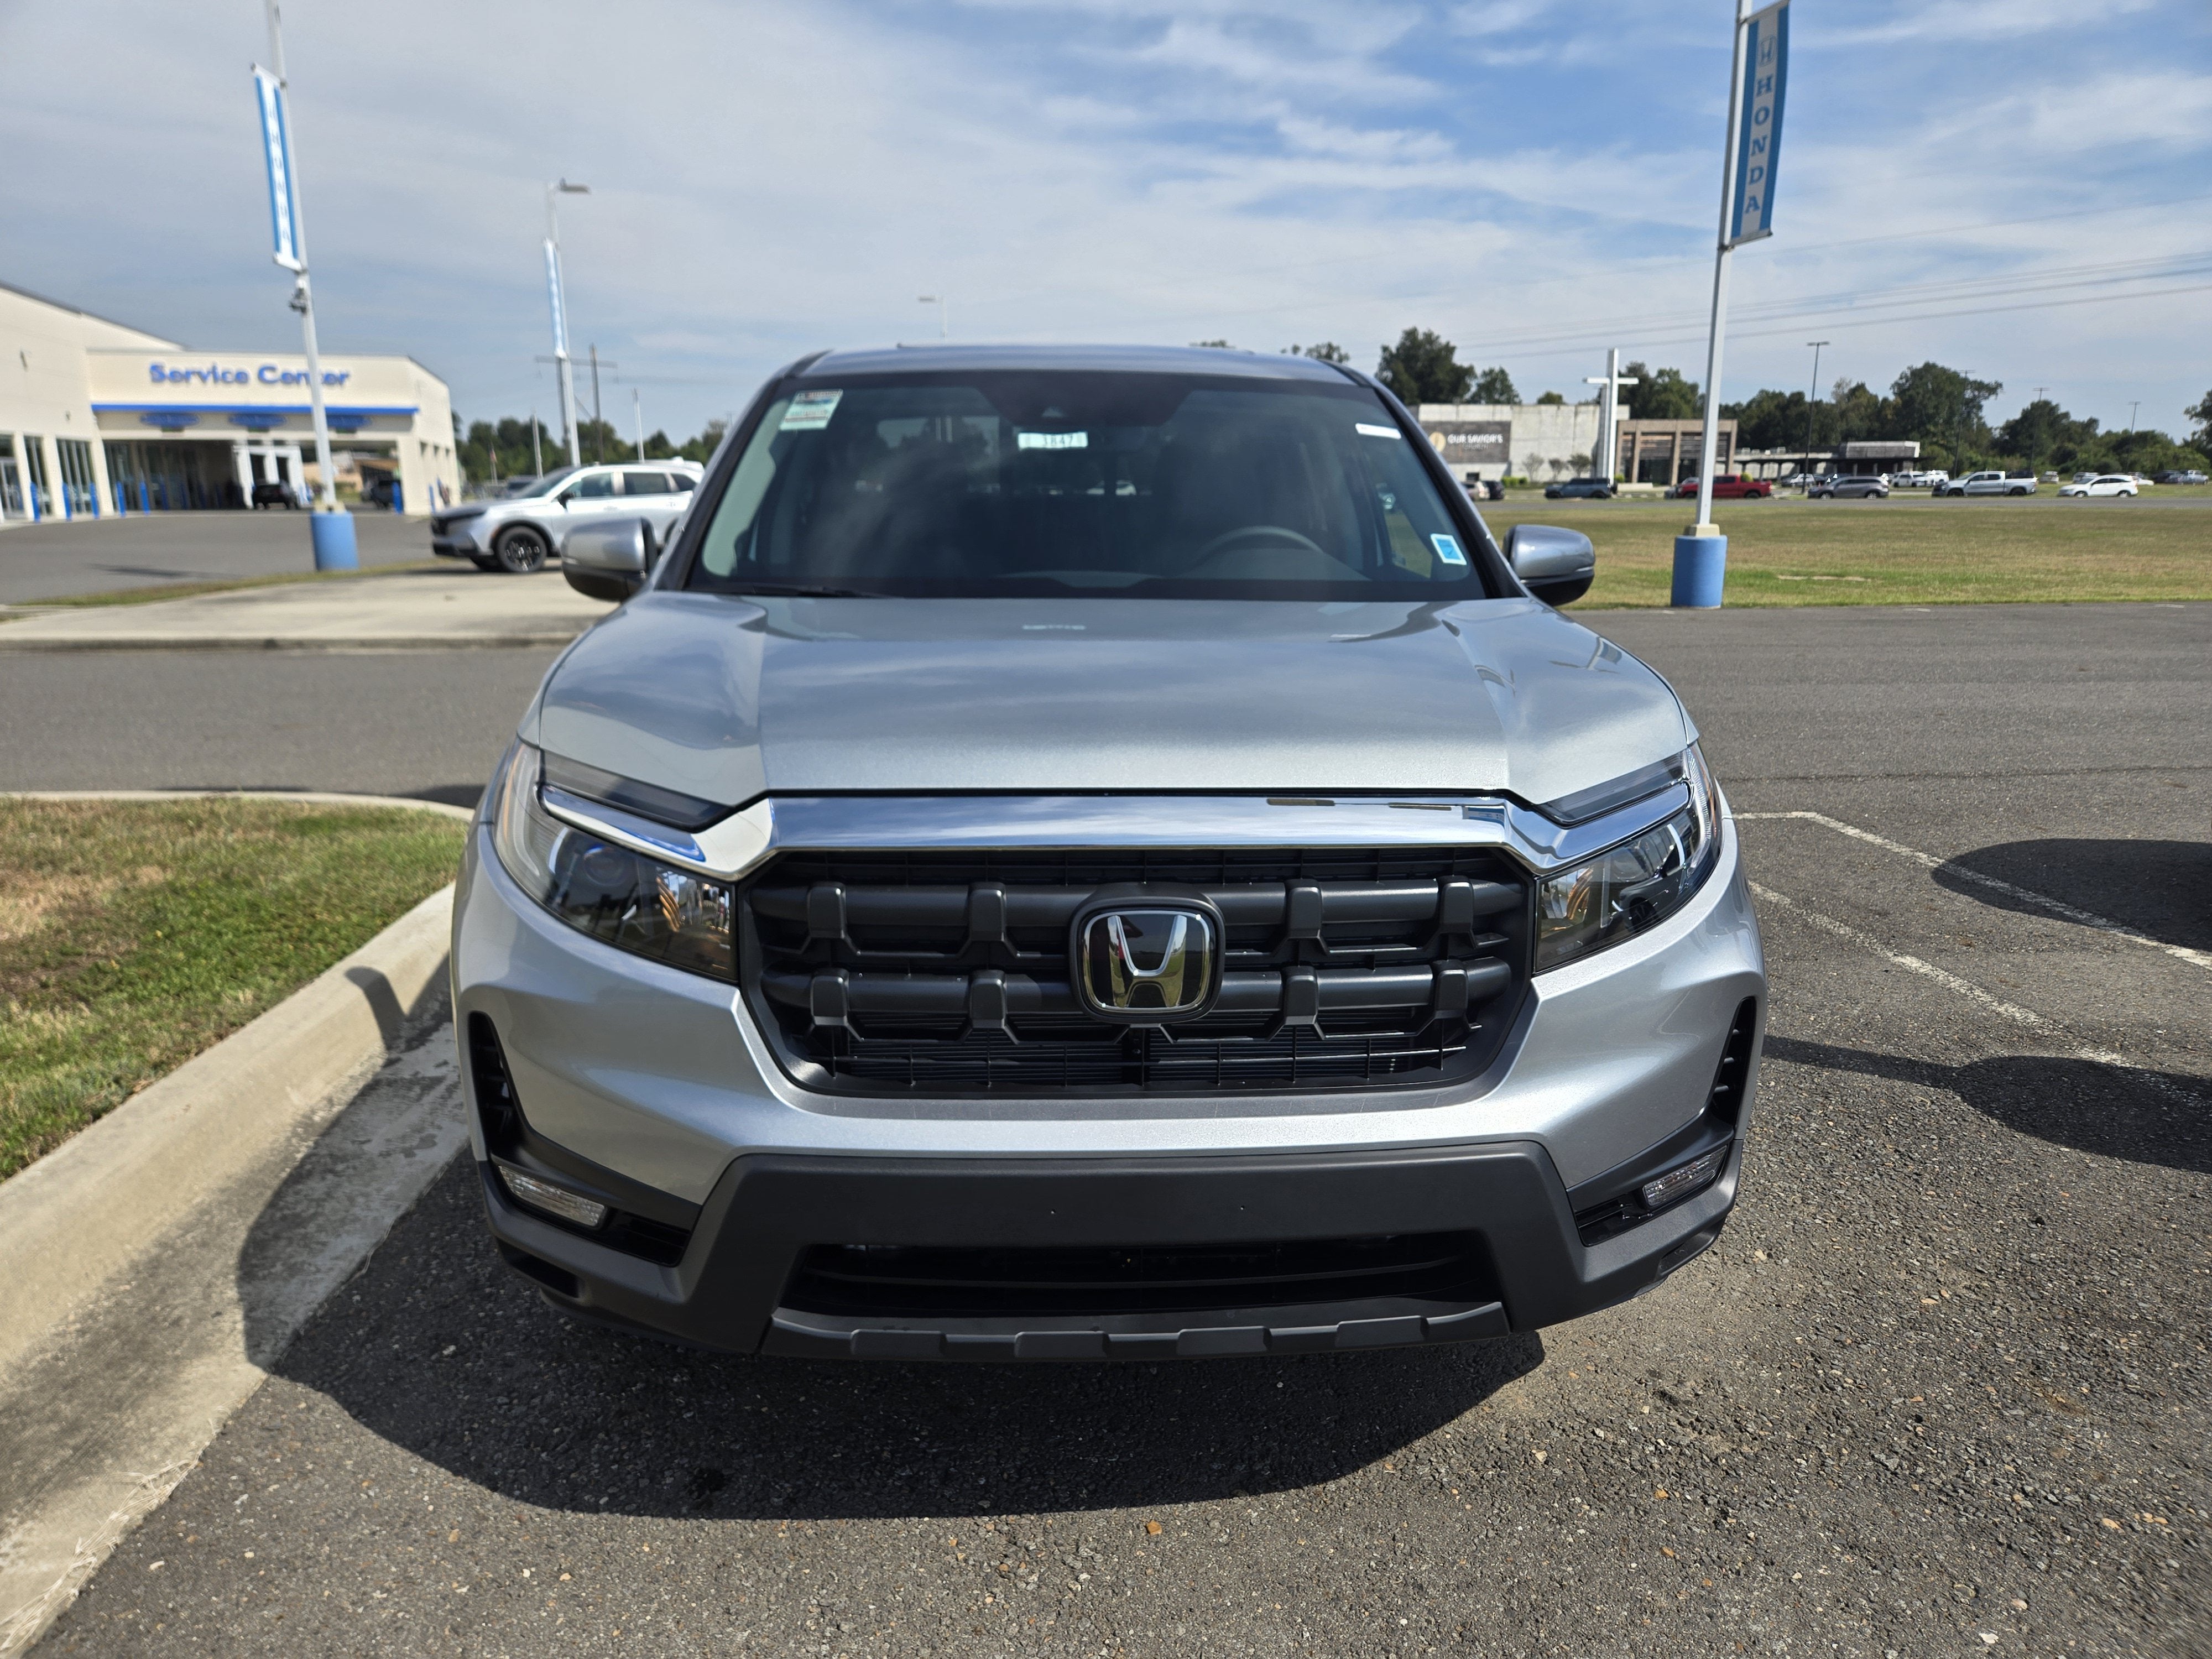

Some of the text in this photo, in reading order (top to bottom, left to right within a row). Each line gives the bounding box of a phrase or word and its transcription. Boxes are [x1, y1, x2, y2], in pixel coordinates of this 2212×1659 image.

[1745, 75, 1772, 213] HONDA
[149, 363, 349, 386] Service Cener
